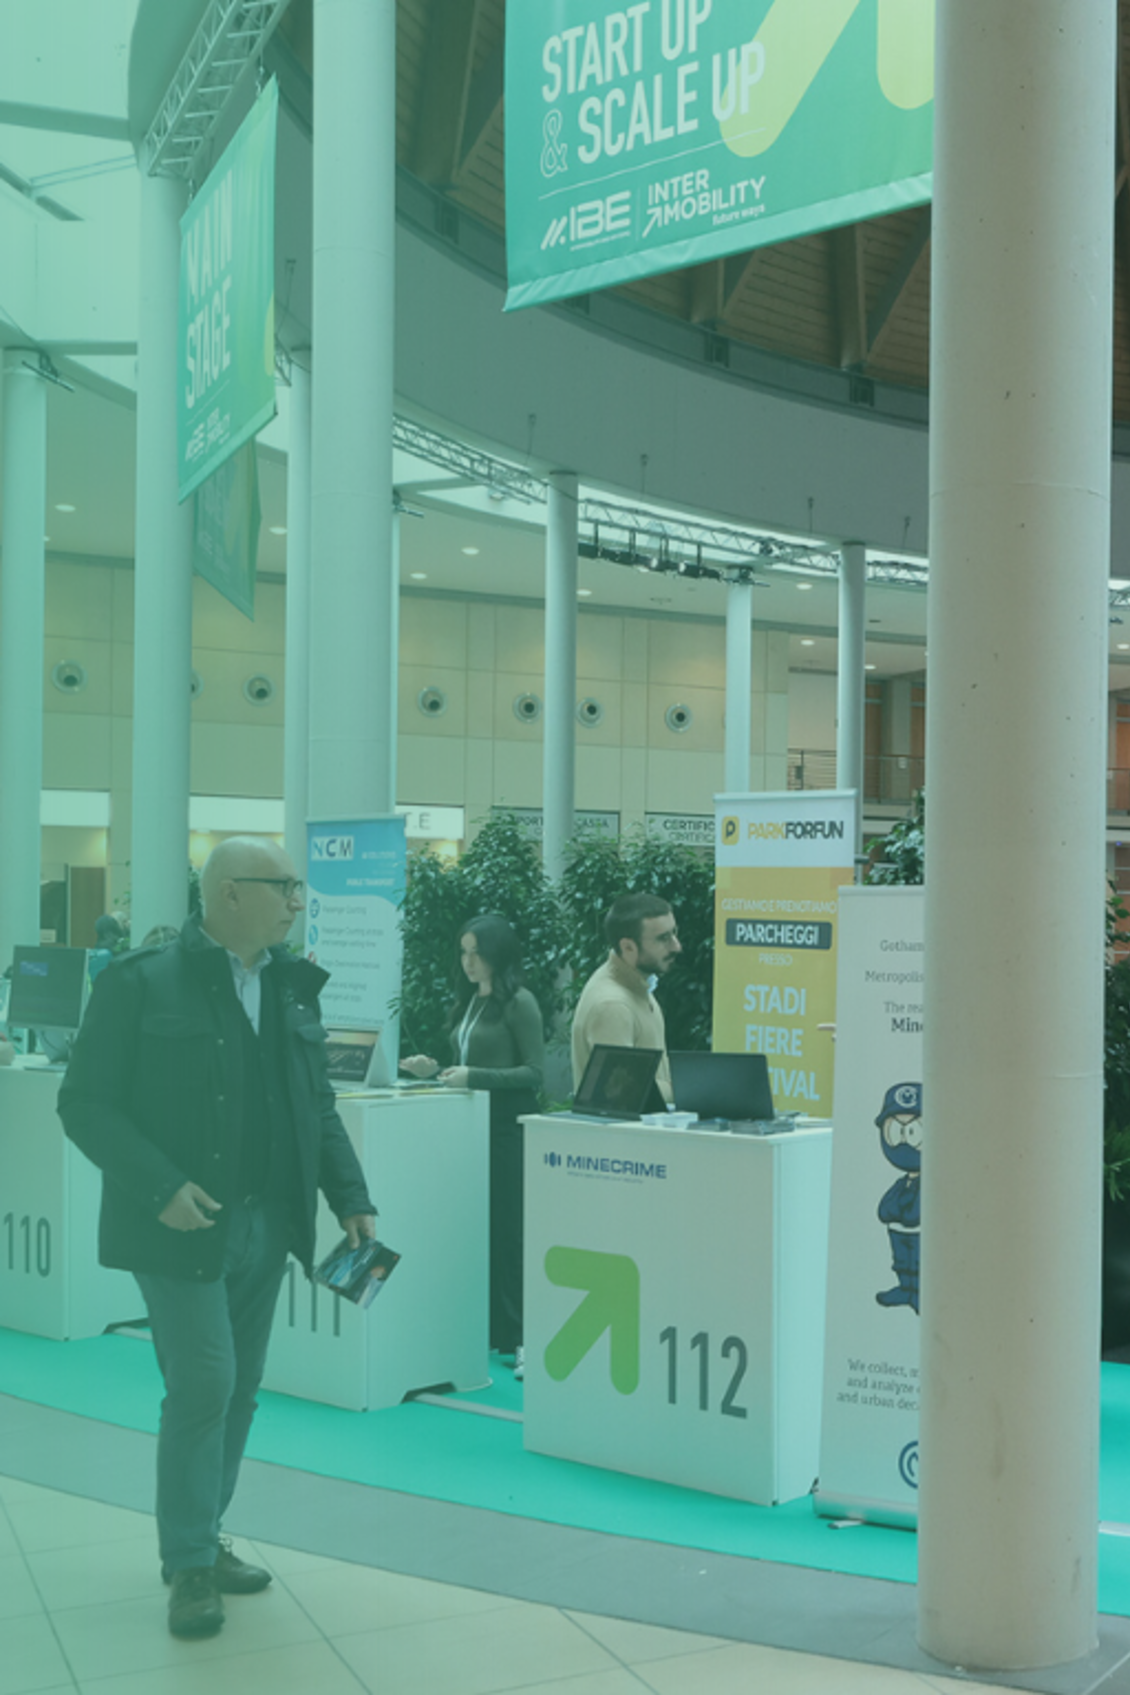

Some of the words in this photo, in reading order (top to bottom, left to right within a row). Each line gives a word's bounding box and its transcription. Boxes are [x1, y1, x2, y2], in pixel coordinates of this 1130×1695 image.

[541, 2, 651, 102] START
[661, 0, 713, 60] UP
[540, 108, 568, 177] &
[577, 61, 699, 164] SCALE
[712, 40, 766, 122] UP
[648, 168, 710, 205] INTER
[664, 175, 767, 226] MOBILITY
[185, 274, 232, 410] STAGE
[663, 818, 715, 831] CERTIFIC
[748, 820, 844, 840] PARKFORFUN
[313, 838, 353, 857] NCM
[735, 923, 820, 946] PARCHEGGI
[759, 952, 794, 966] PRESSO
[743, 984, 806, 1016] STADI
[907, 1003, 923, 1014] rea
[745, 1023, 804, 1058] FIERE
[768, 1065, 820, 1101] IVAL
[567, 1153, 667, 1180] MINECRIME
[4, 1211, 51, 1278] 110
[658, 1325, 748, 1419] 112
[848, 1358, 865, 1372] We
[837, 1391, 859, 1404] and
[861, 1394, 894, 1409] urban
[847, 1377, 868, 1390] and
[871, 1381, 914, 1396] analyze
